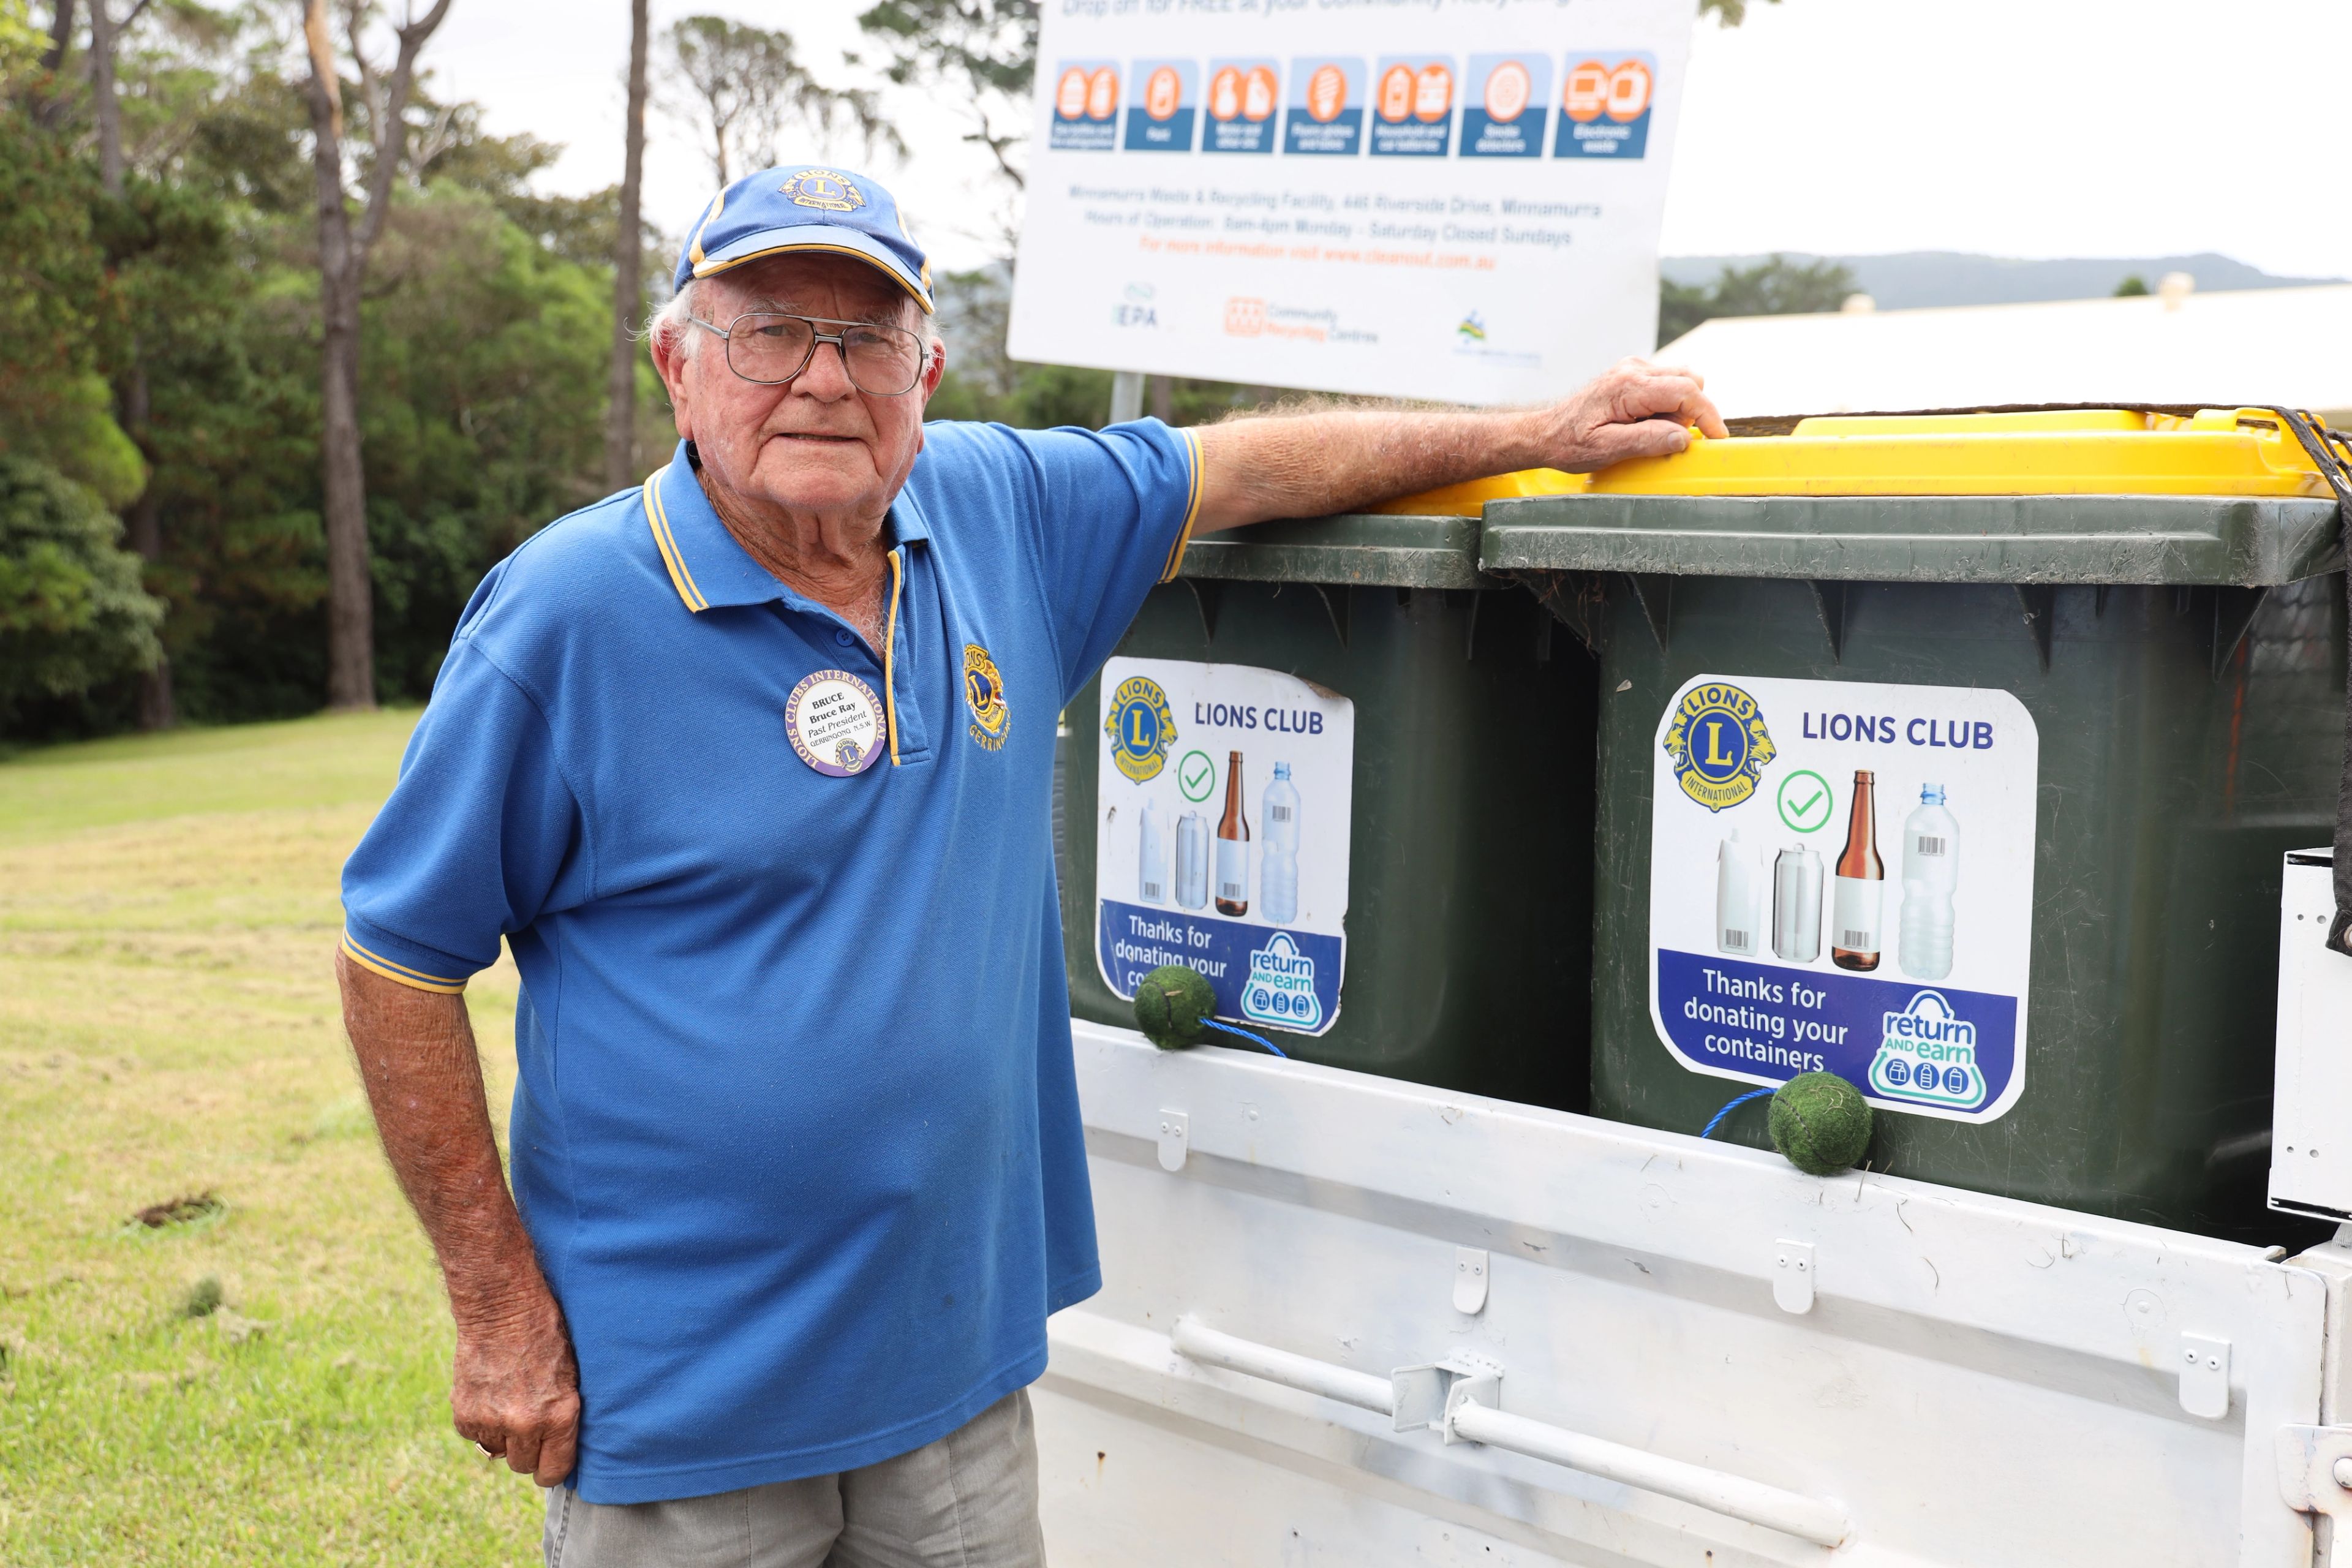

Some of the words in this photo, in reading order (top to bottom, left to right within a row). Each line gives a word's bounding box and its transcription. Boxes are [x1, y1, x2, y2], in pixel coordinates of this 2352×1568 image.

[799, 170, 847, 183] LIONS
[815, 179, 836, 196] L
[1118, 306, 1158, 326] EPA
[786, 681, 809, 723] CLUBS
[812, 692, 845, 710] BRUCE
[969, 675, 988, 706] L
[1120, 680, 1161, 704] LIONS
[1687, 687, 1752, 715] LIONS
[809, 669, 887, 742] INTERNATIONAL
[809, 710, 837, 724] Bruce
[839, 703, 856, 714] Ray
[1195, 702, 1257, 729] LIONS
[1264, 708, 1324, 734] CLUB
[808, 725, 826, 738] Past
[828, 710, 867, 731] President
[810, 728, 851, 747] GERRINGONG
[854, 720, 872, 732] N.S.W.
[1131, 709, 1150, 747] L
[1803, 712, 1896, 744] LIONS
[1906, 718, 1994, 750] CLUB
[788, 728, 819, 768] LIONS
[837, 740, 854, 748] LIONS
[843, 749, 856, 763] L
[1705, 722, 1733, 766] L
[1118, 754, 1159, 775] INTERNATIONAL
[1686, 775, 1748, 801] INTERNATIONAL
[1129, 914, 1183, 944] Thanks
[1188, 925, 1212, 949] for
[1115, 938, 1183, 967] donating
[1188, 956, 1227, 978] your
[1253, 952, 1311, 976] return
[1253, 971, 1273, 983] AND
[1273, 974, 1311, 993] earn
[1703, 968, 1784, 1003] Thanks
[1791, 982, 1826, 1009] for
[1684, 996, 1785, 1039] donating
[1792, 1019, 1849, 1046] your
[1887, 1015, 1972, 1045] return
[1705, 1034, 1824, 1072] containers
[1885, 1038, 1915, 1052] AND
[1917, 1042, 1971, 1065] earn
